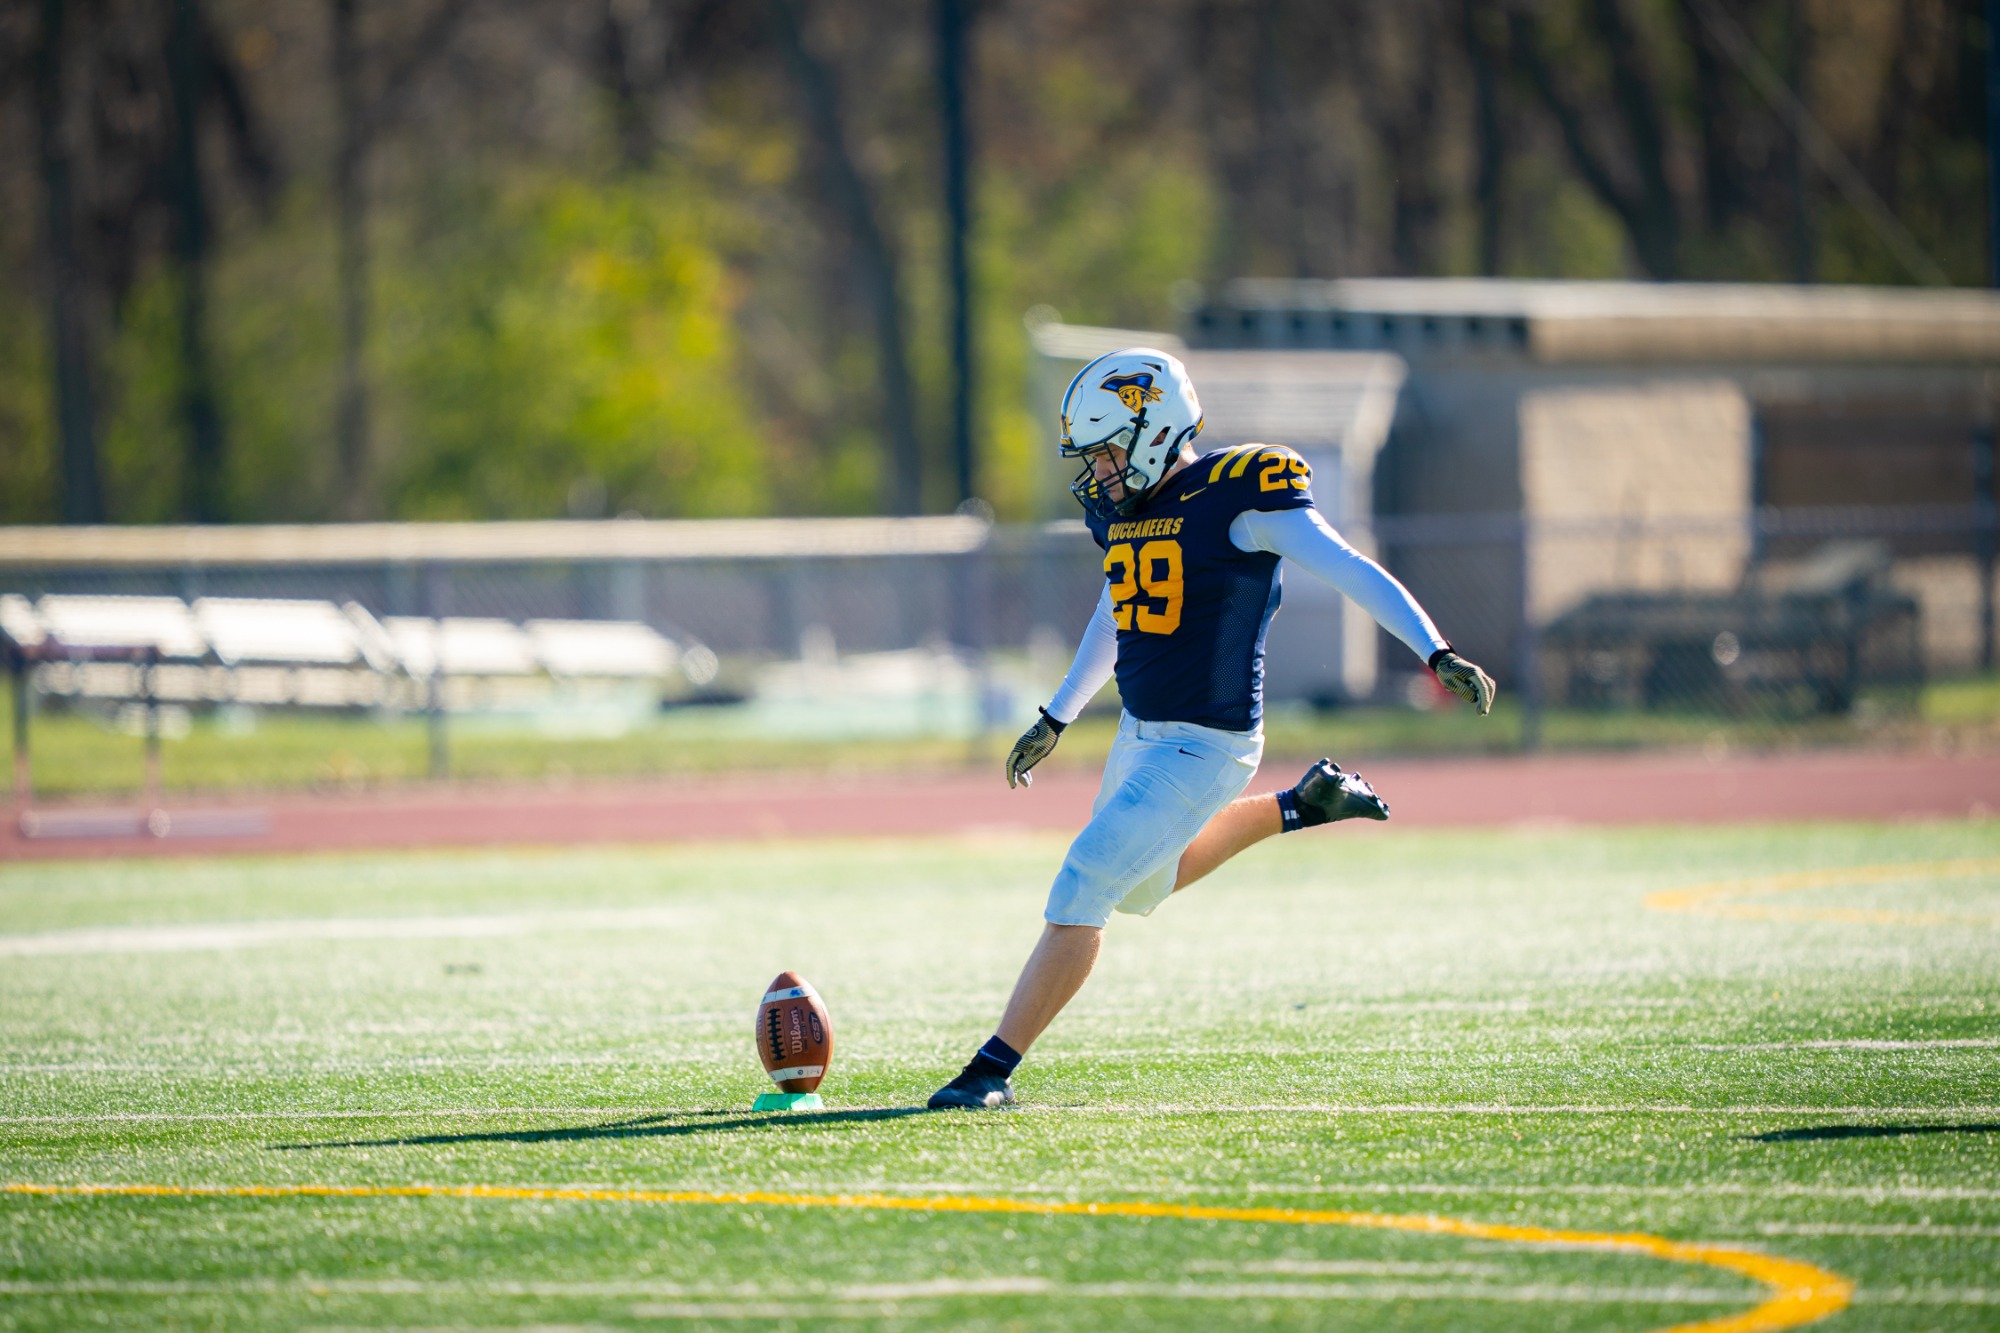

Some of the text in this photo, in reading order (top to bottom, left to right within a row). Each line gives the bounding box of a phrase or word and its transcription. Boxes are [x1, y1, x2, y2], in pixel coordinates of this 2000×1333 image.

[1259, 452, 1309, 492] 29
[1107, 517, 1184, 541] BUCCANEERS
[1103, 540, 1184, 635] 29
[790, 1009, 803, 1055] Wilson
[810, 1013, 821, 1042] GST
